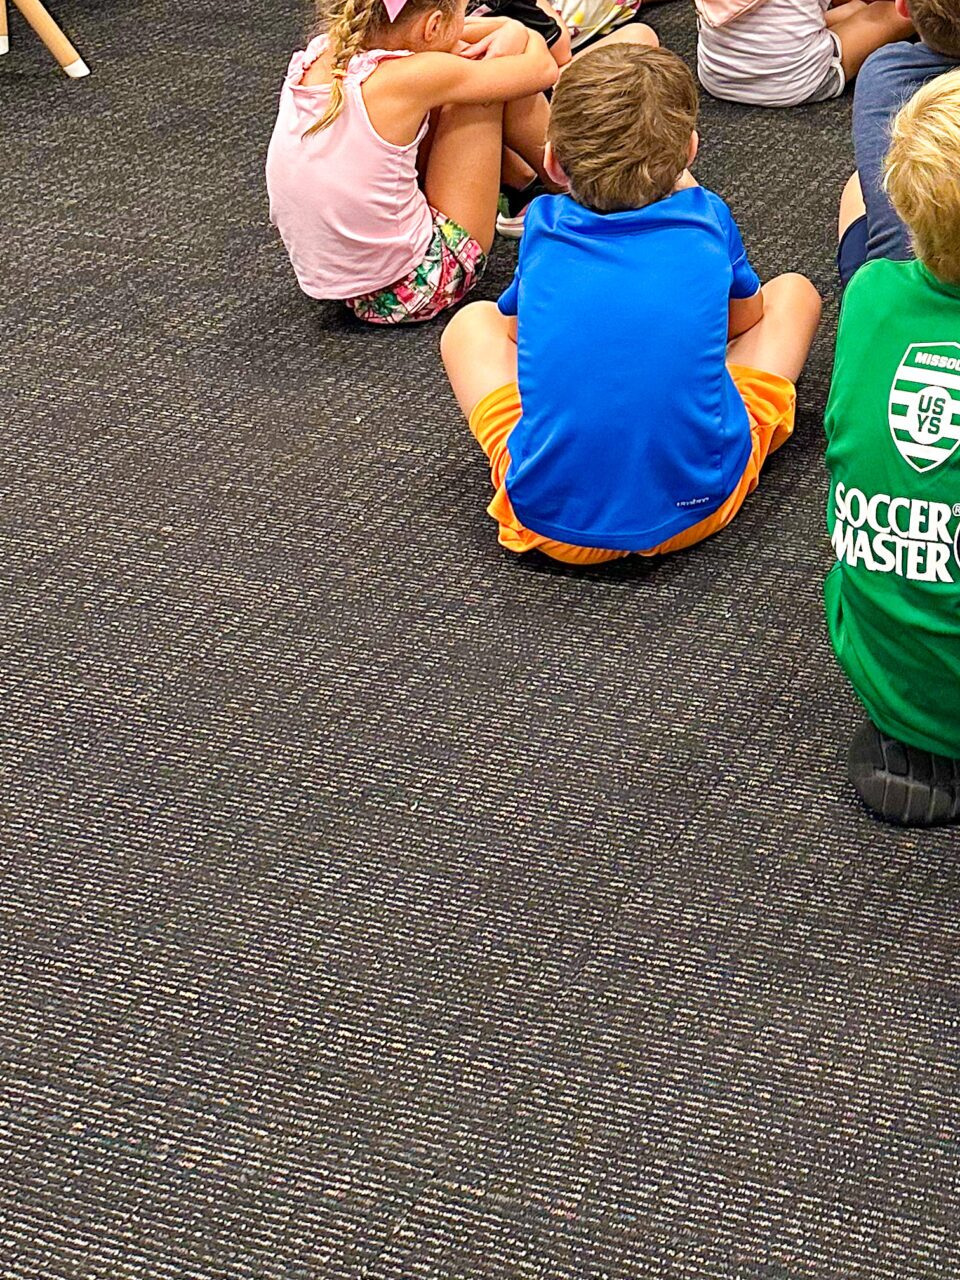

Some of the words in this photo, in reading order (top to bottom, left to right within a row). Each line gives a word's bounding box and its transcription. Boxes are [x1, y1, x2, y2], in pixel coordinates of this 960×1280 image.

[917, 394, 946, 416] US
[916, 413, 942, 435] YS
[830, 518, 955, 584] MASTER
